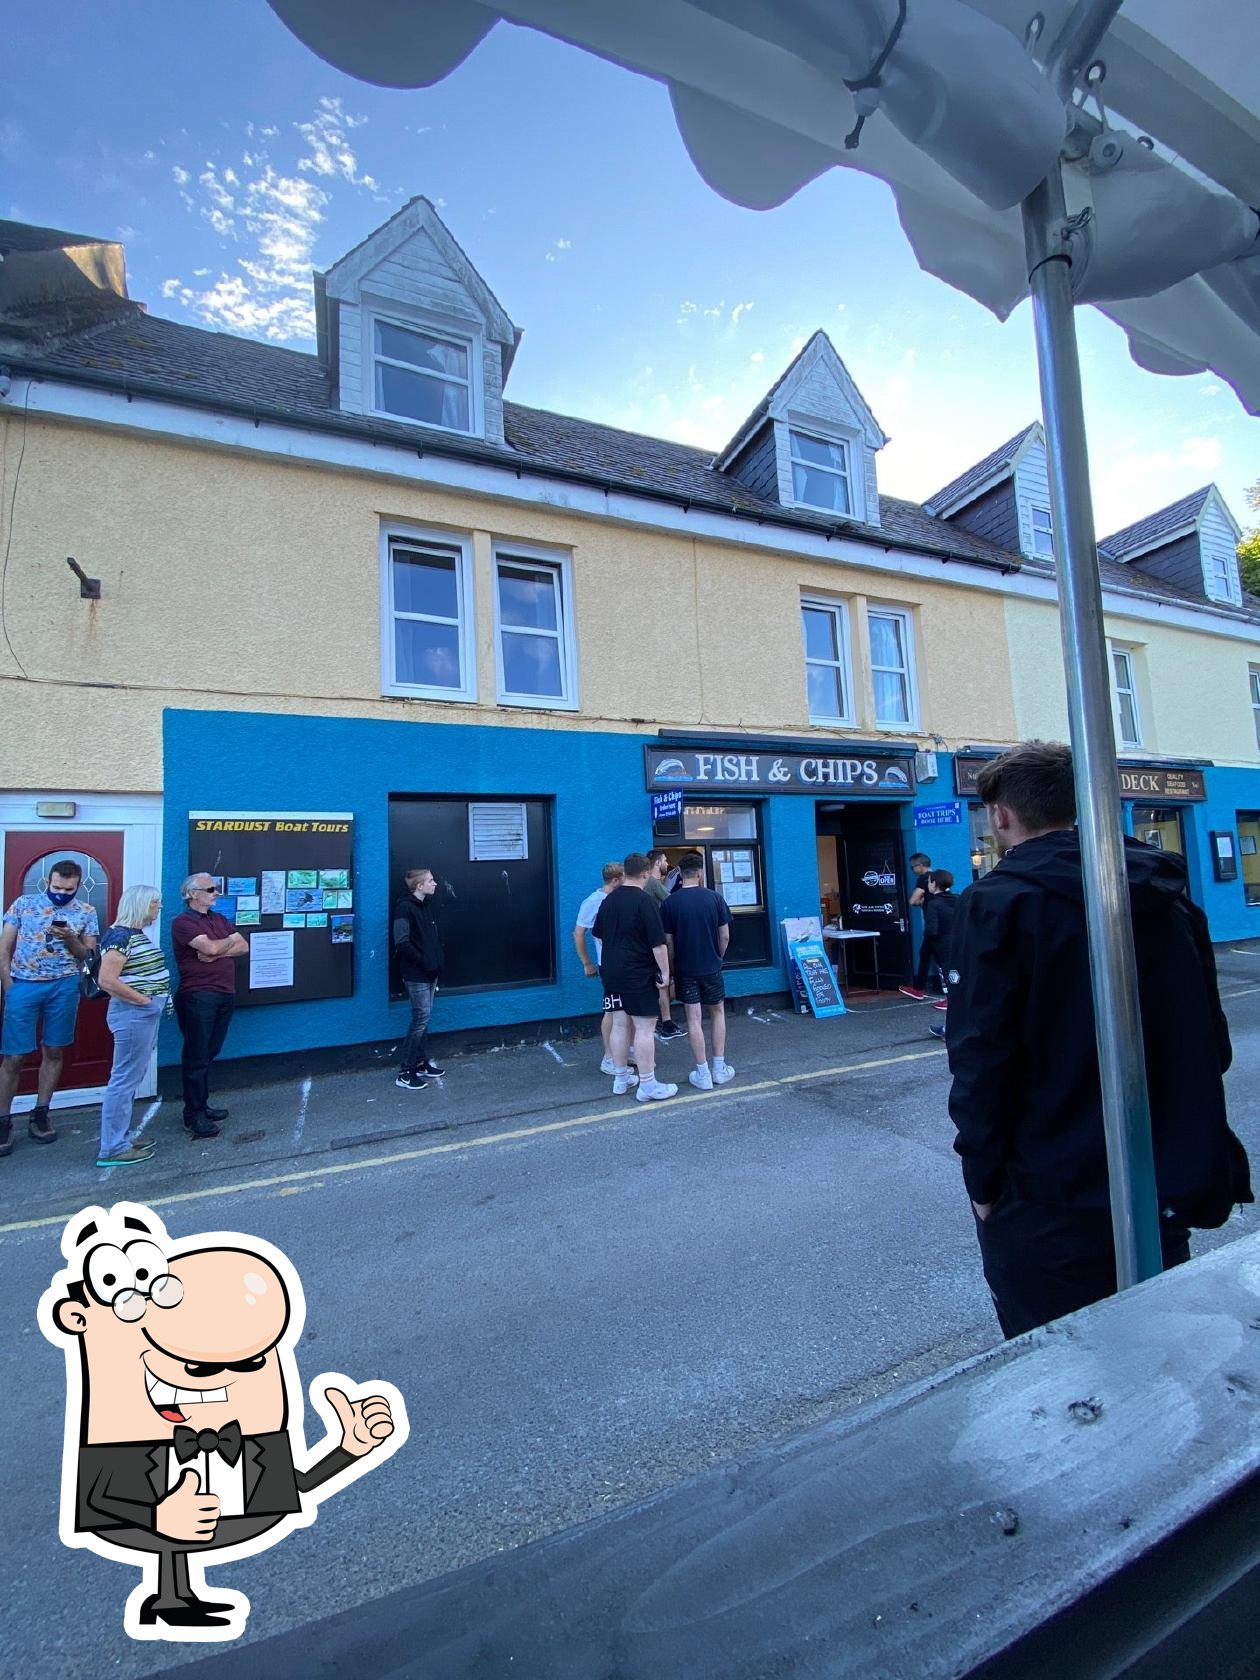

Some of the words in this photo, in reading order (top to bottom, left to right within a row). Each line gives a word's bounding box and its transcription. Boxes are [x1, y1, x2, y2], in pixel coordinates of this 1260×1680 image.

[695, 754, 760, 782] FISH
[767, 758, 791, 783] &
[799, 759, 878, 785] CHIPS
[1120, 774, 1160, 791] DECK
[668, 791, 682, 801] Chips
[918, 811, 935, 819] BOAT
[936, 809, 956, 817] TRIPS
[196, 821, 272, 832] STARDUST
[275, 821, 309, 832] Boat
[311, 822, 350, 833] Tours
[602, 994, 623, 1010] BH
